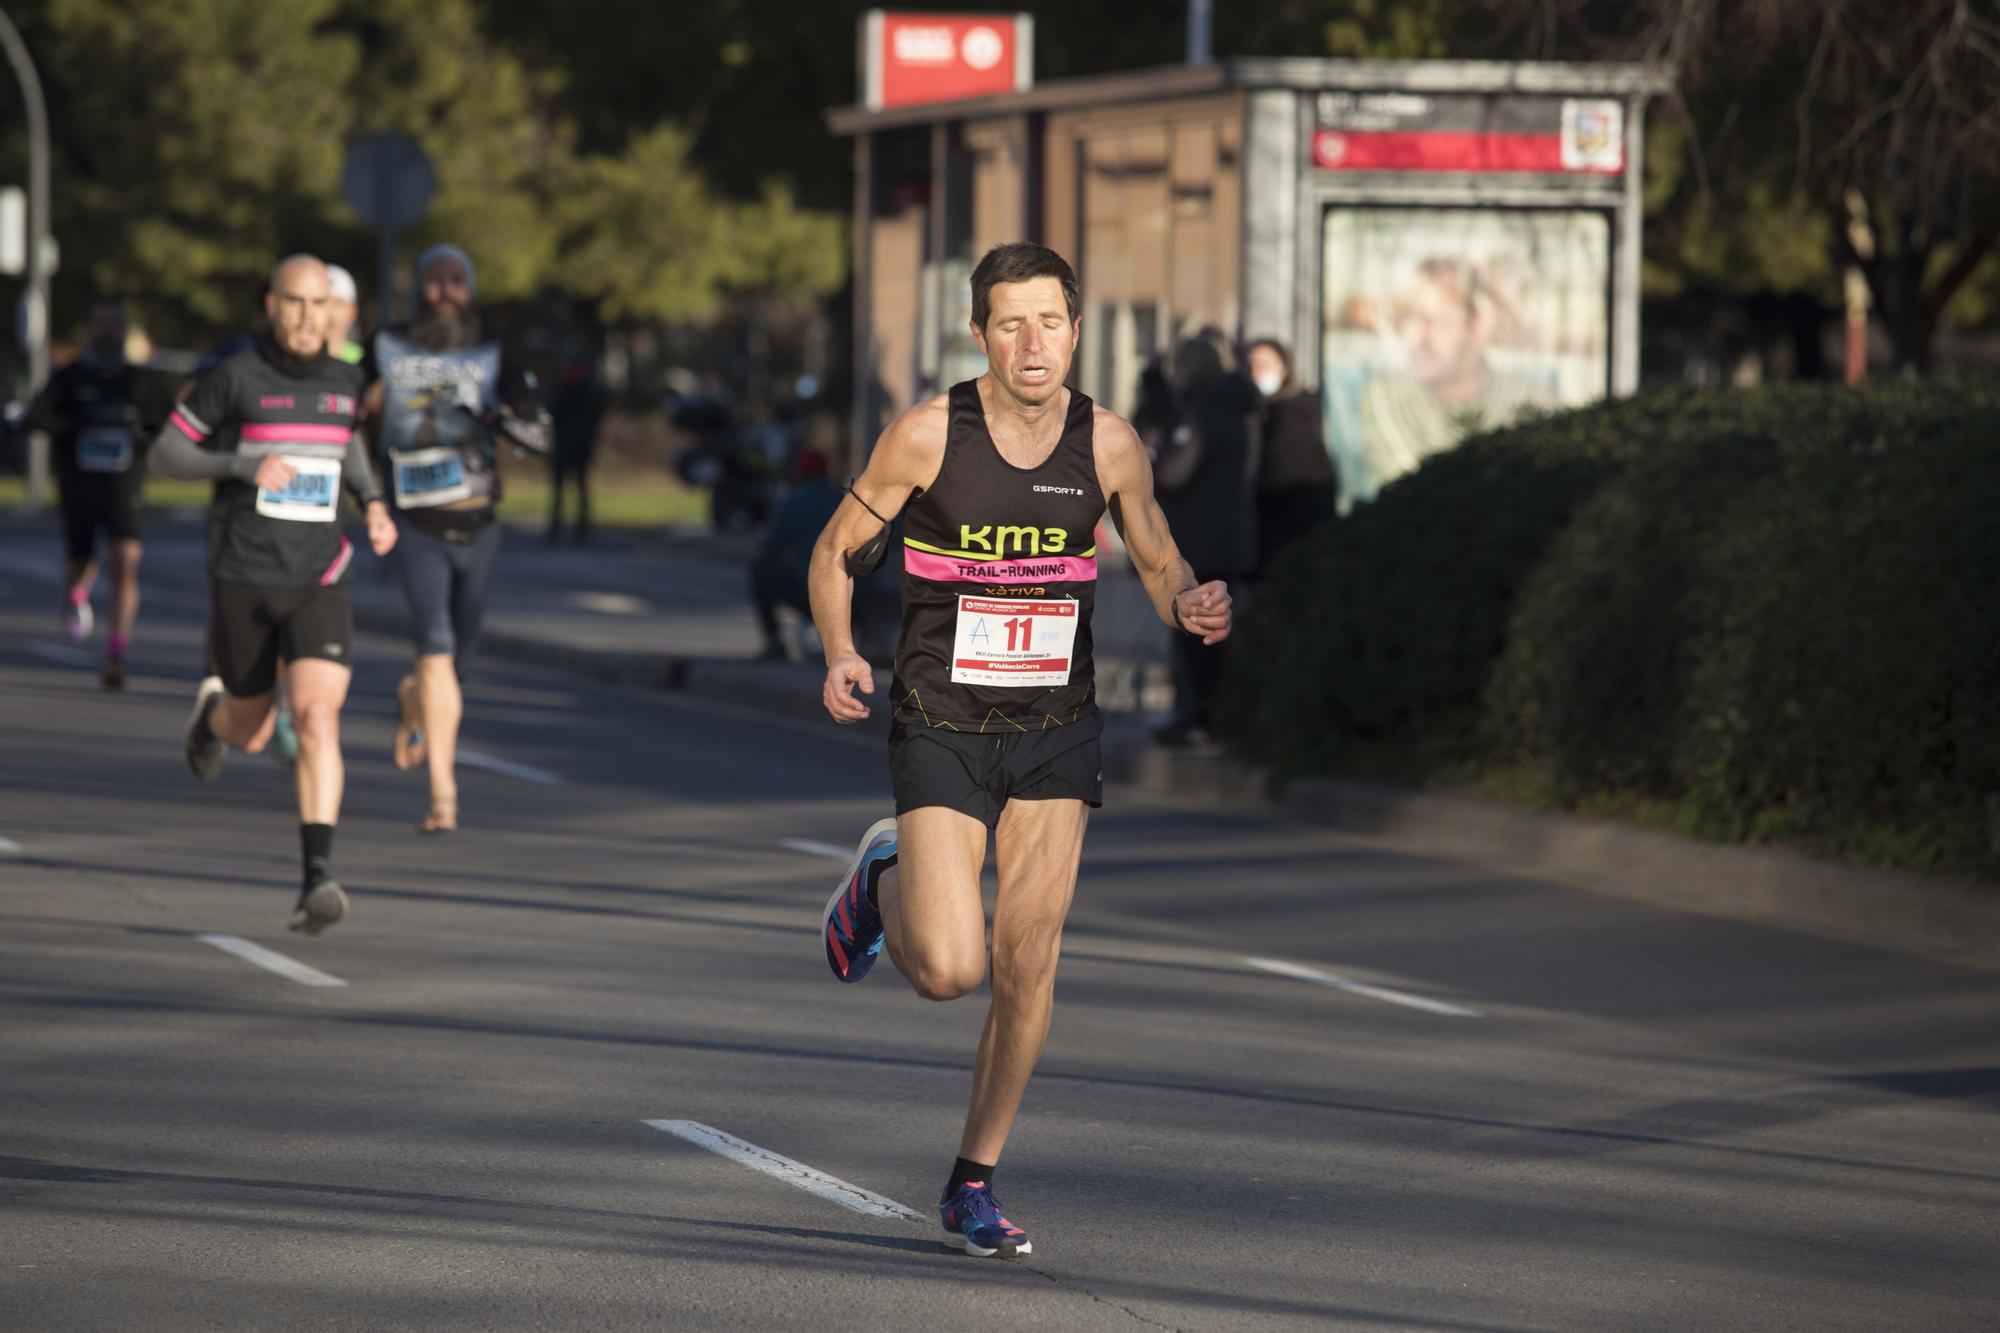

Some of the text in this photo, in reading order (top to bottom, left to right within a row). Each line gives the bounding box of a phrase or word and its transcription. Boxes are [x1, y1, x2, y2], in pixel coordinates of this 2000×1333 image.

[1033, 485, 1076, 495] GSPORT
[957, 563, 1066, 578] TRAIL-RUNNING
[969, 617, 989, 645] A
[1003, 617, 1033, 651] 11
